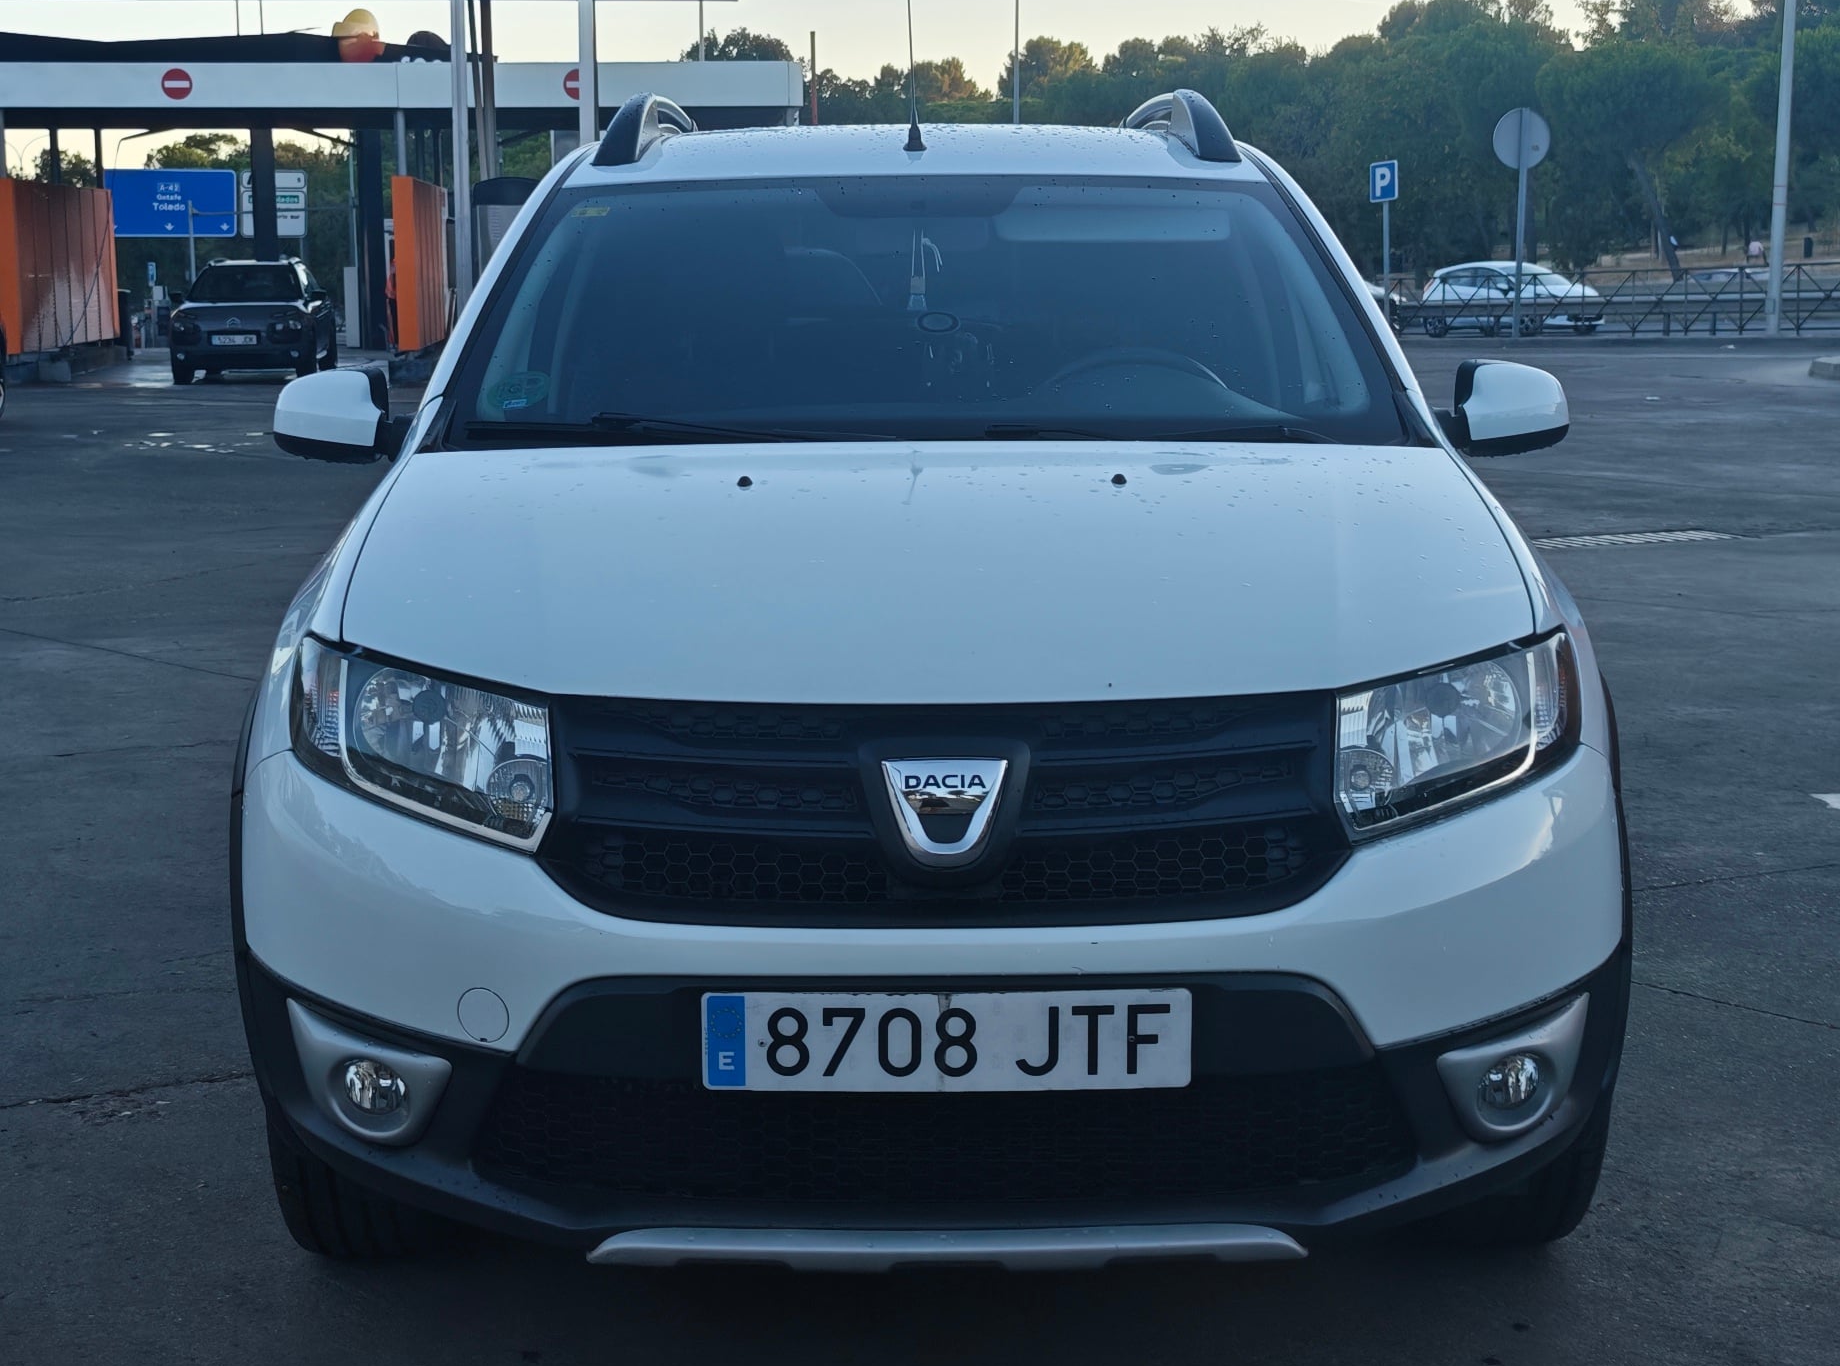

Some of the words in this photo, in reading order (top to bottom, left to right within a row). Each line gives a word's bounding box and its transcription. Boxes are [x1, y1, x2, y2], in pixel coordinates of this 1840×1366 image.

[1375, 166, 1391, 197] P
[156, 193, 182, 201] Getafe
[152, 202, 186, 211] Toledo
[904, 774, 987, 790] DACIA
[718, 1051, 735, 1070] E
[766, 1006, 978, 1078] 8708
[1015, 1003, 1171, 1076] JTF
